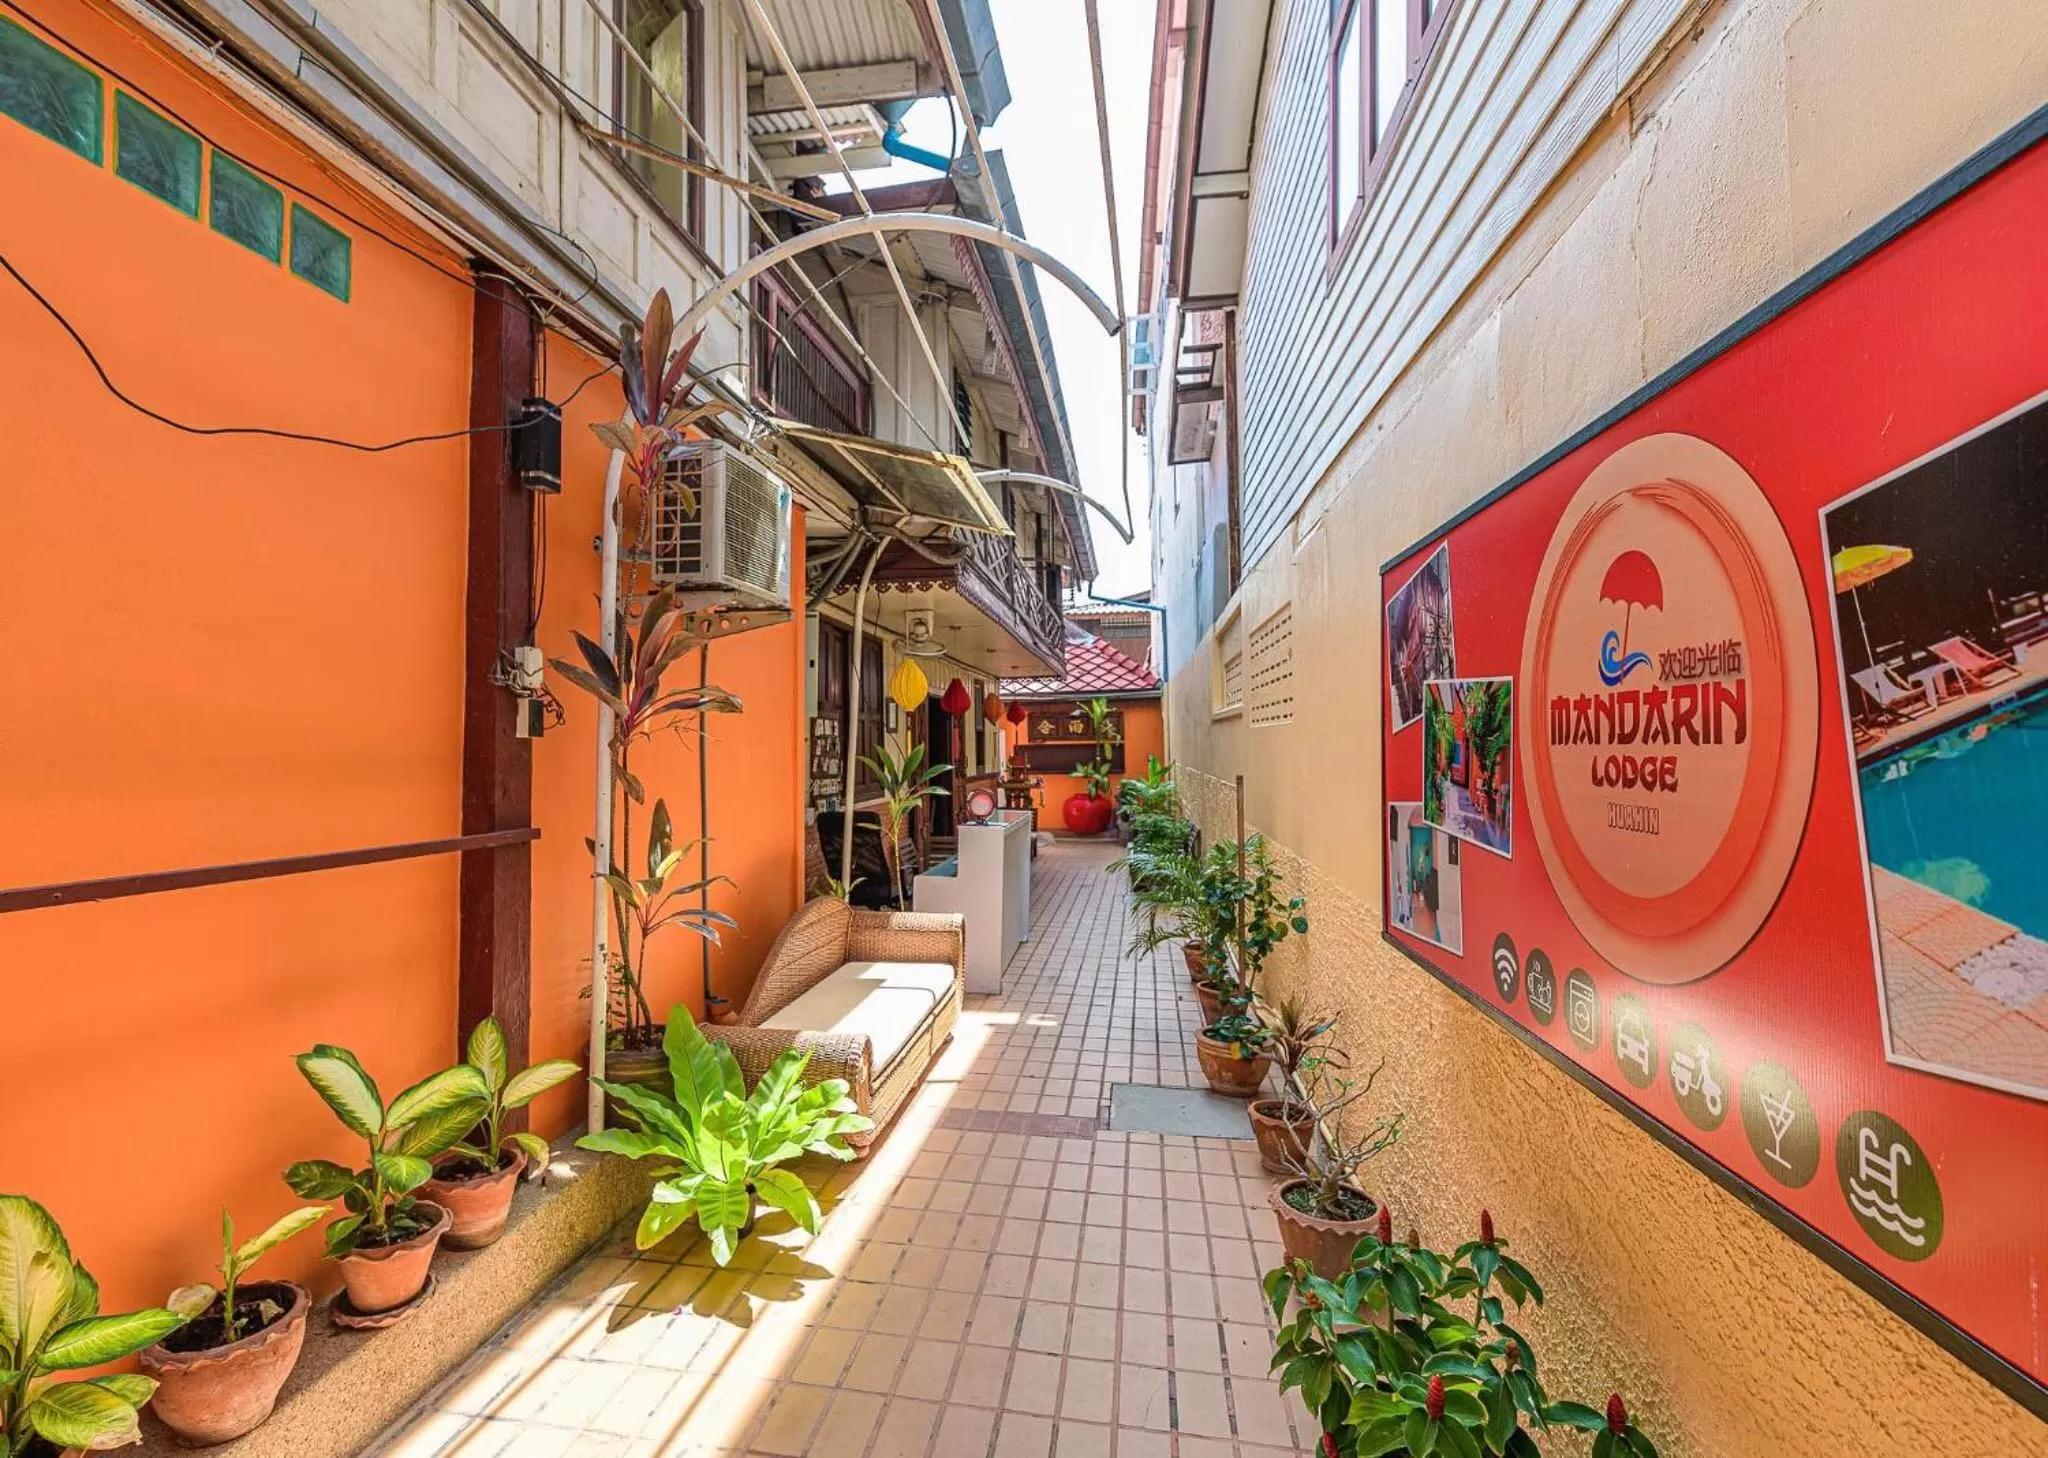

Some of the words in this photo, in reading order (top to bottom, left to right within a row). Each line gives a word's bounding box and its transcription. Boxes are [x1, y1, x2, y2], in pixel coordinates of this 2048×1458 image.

[1658, 638, 1741, 681] 欢迎光临
[1550, 678, 1747, 746] MANDARIN
[1591, 754, 1679, 793] LODGE
